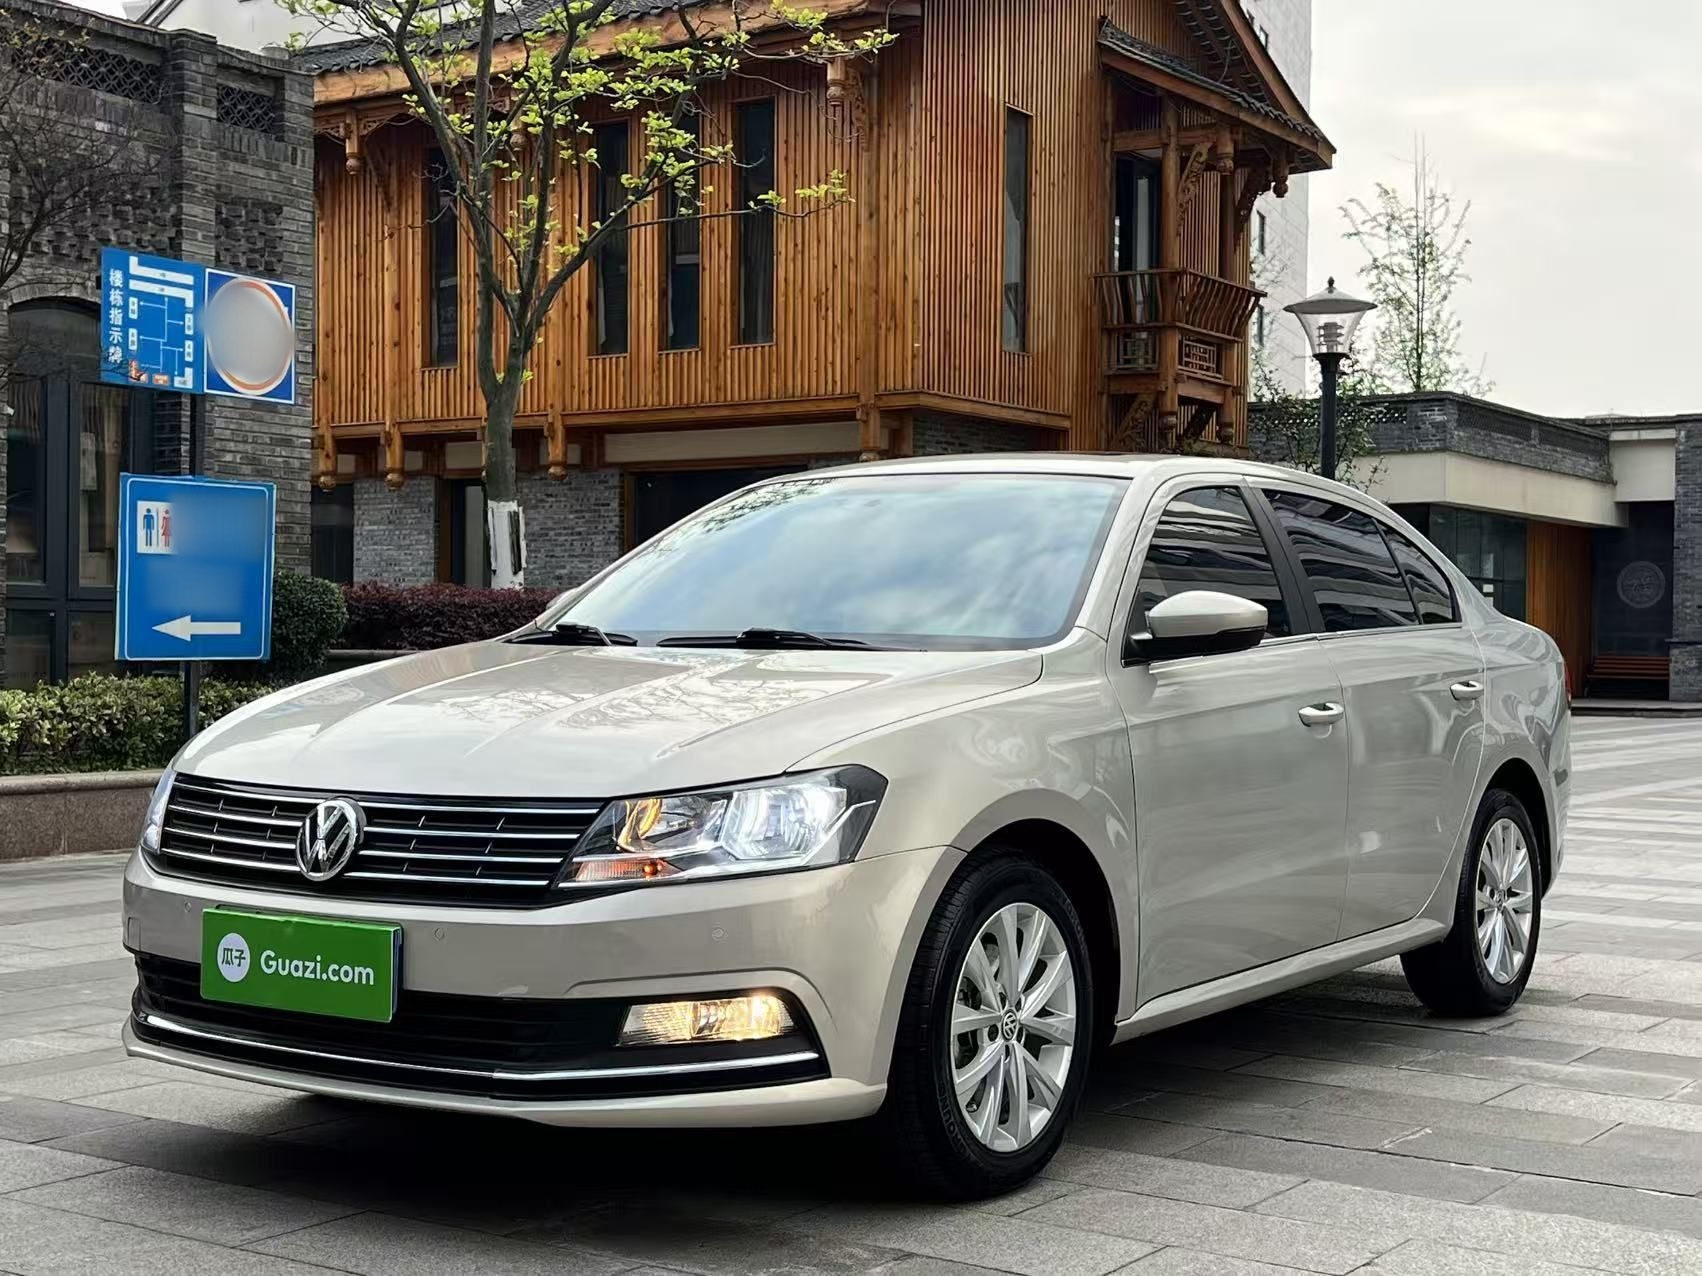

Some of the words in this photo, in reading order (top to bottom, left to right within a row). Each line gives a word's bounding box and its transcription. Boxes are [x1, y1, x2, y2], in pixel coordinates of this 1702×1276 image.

[109, 268, 123, 364] 楼栋指示牌
[221, 946, 246, 968] 瓜子
[260, 949, 374, 986] Guazi.com
